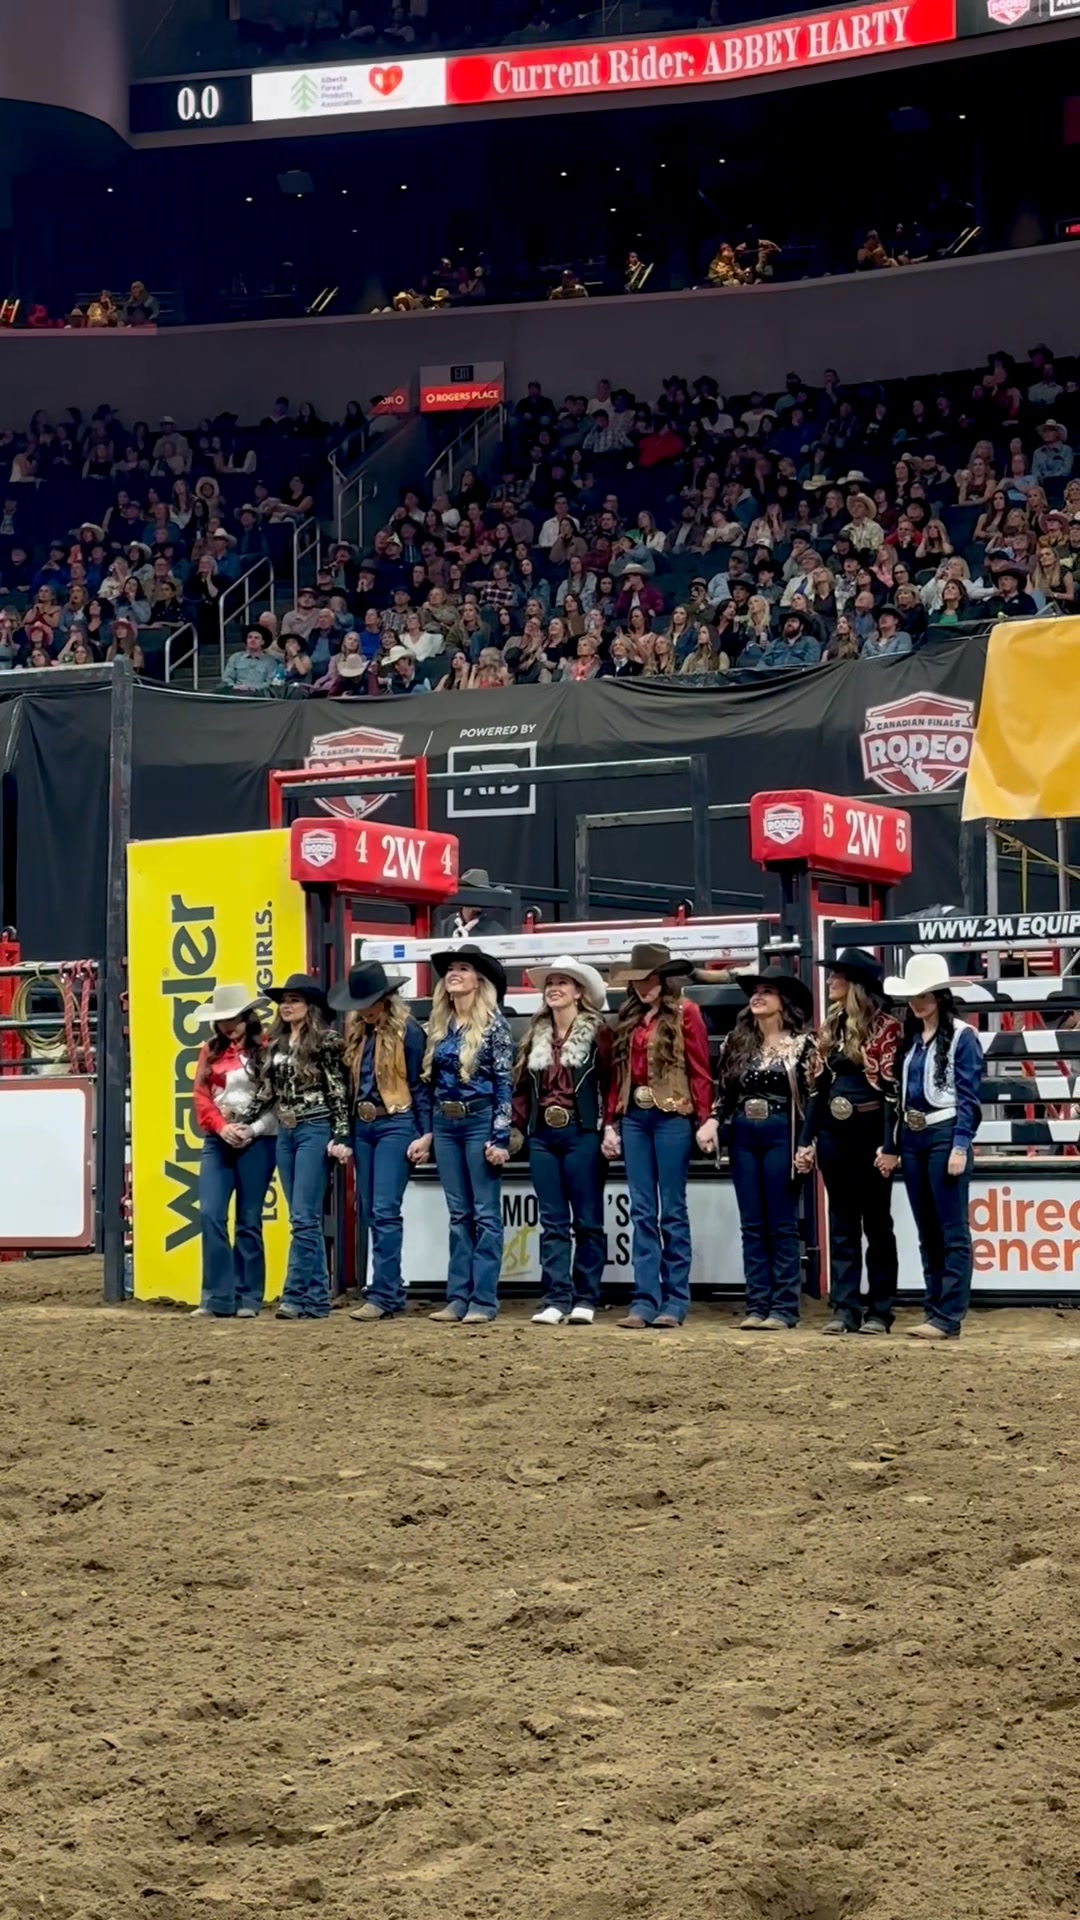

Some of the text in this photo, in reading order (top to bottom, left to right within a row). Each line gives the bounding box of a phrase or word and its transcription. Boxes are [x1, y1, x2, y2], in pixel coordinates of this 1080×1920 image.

[493, 5, 910, 94] Current Rider: ABBEY HARTY
[176, 84, 219, 120] 0.0
[435, 389, 499, 402] ROGERS PLACE
[459, 724, 536, 738] POWERED BY
[877, 718, 961, 730] CANADIAN FINALS
[868, 734, 969, 767] RODEO
[767, 819, 800, 831] RODEO
[822, 803, 907, 858] 5 2W 5
[355, 831, 453, 881] 4 2W 4
